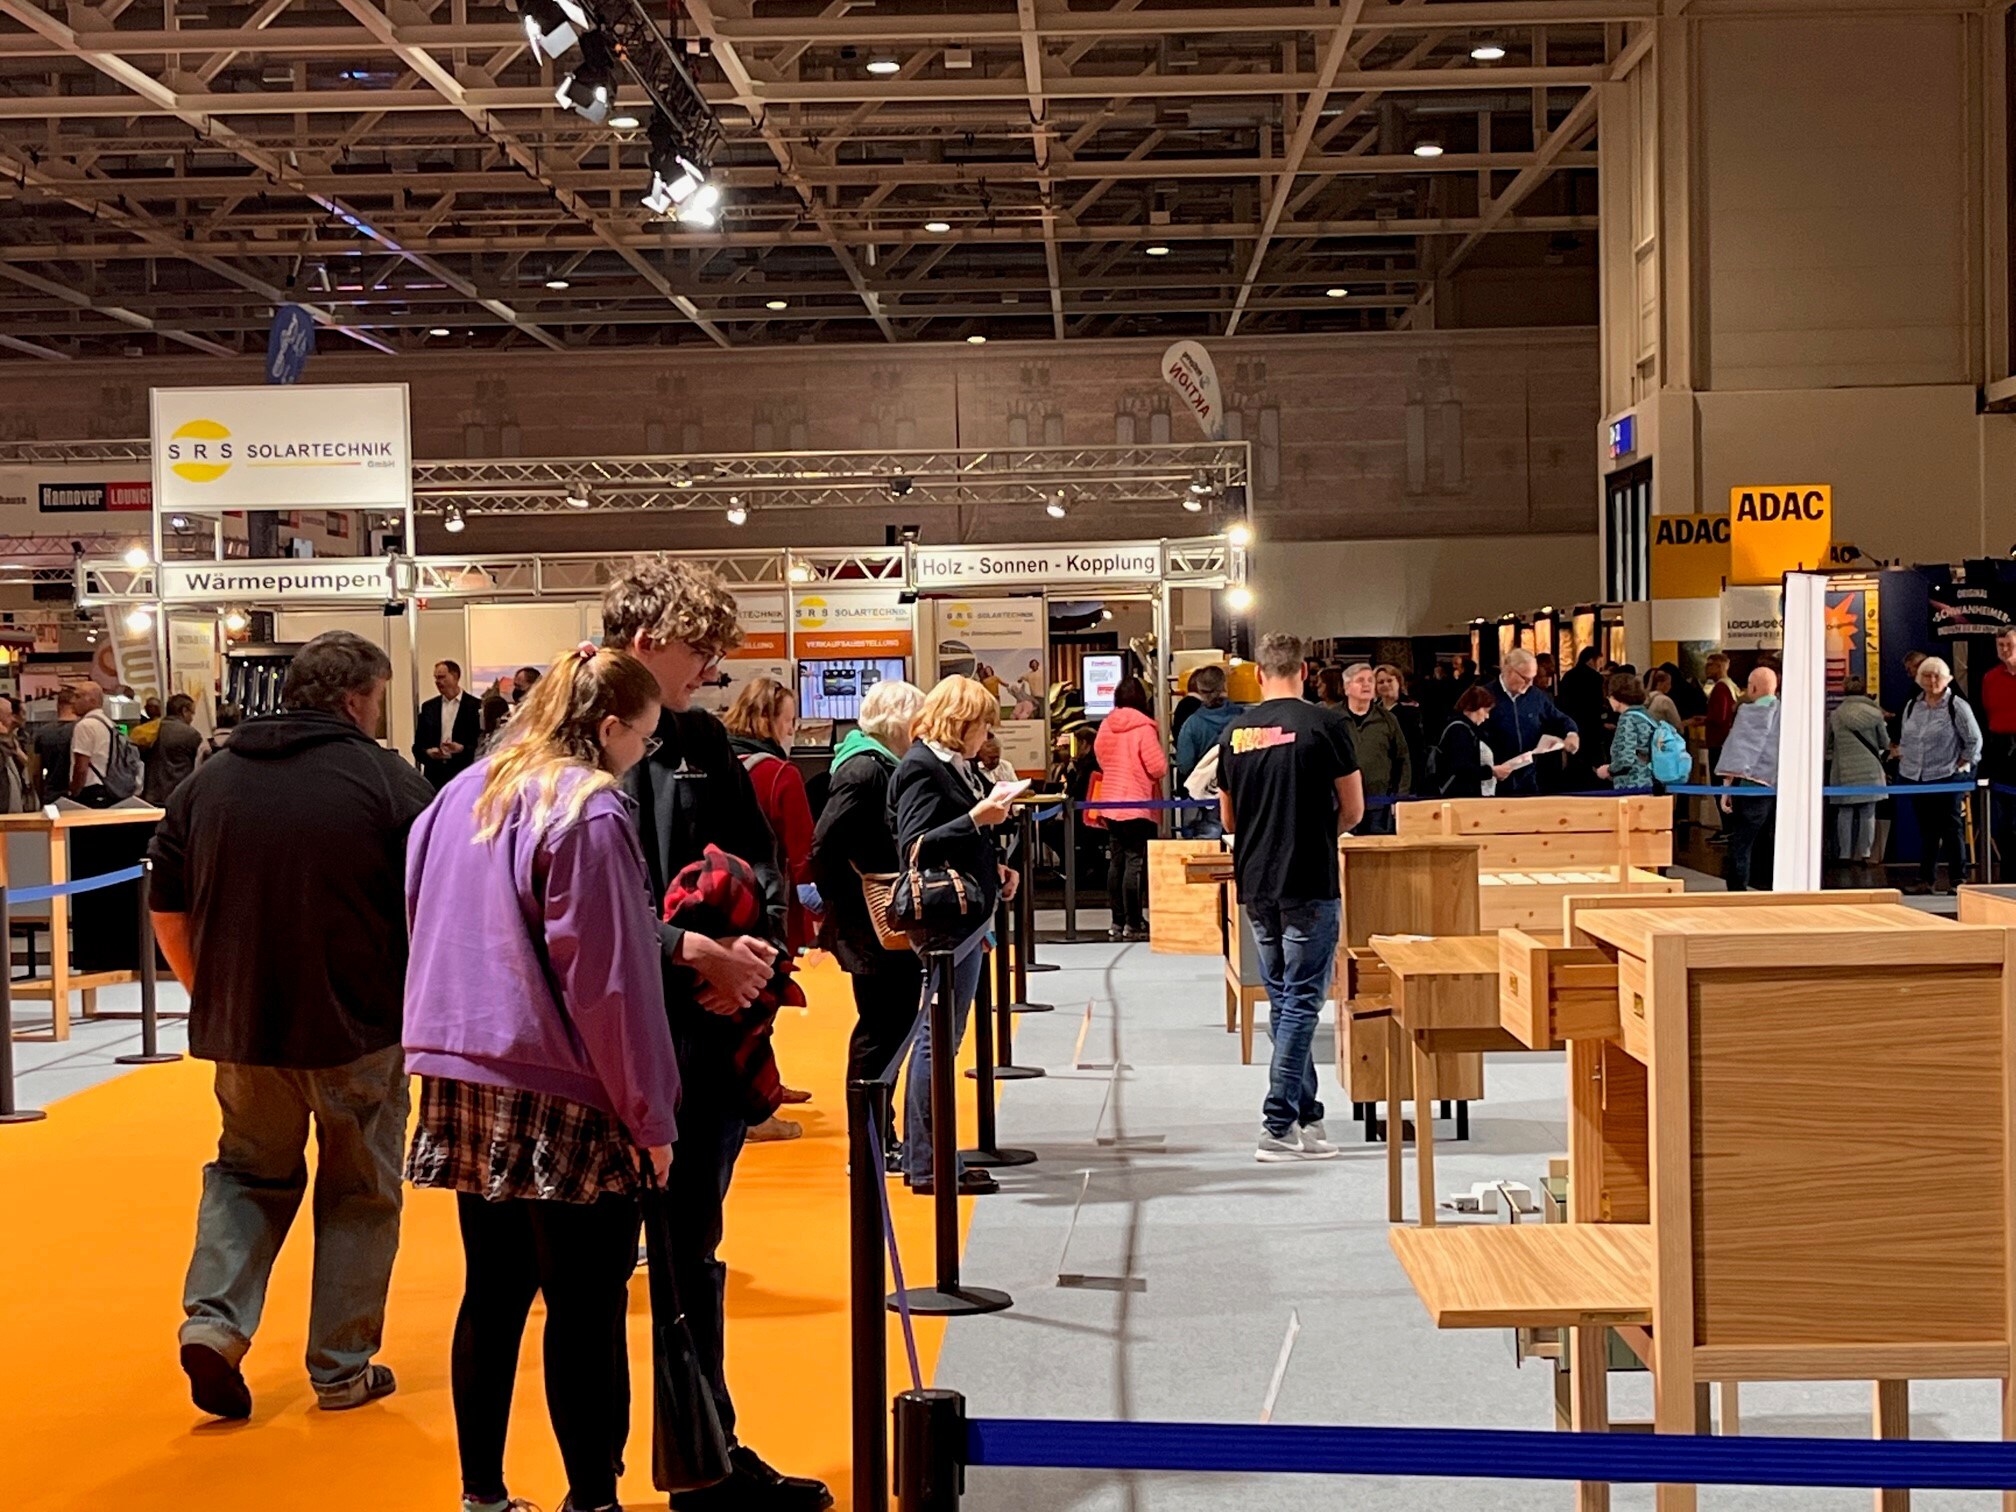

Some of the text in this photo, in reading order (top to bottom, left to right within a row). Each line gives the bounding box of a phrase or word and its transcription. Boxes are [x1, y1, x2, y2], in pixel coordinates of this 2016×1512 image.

[247, 442, 393, 458] SOLARTECHNIK
[367, 460, 396, 468] GmbH
[43, 487, 103, 506] Hannover
[1736, 491, 1824, 521] ADAC
[1655, 518, 1731, 545] ADAC
[922, 559, 963, 576] Holz
[979, 557, 1049, 574] Sonnen
[1066, 554, 1155, 574] Kopplung
[185, 572, 382, 593] Wärmepumpen
[834, 608, 908, 617] SOLARTECHNIK
